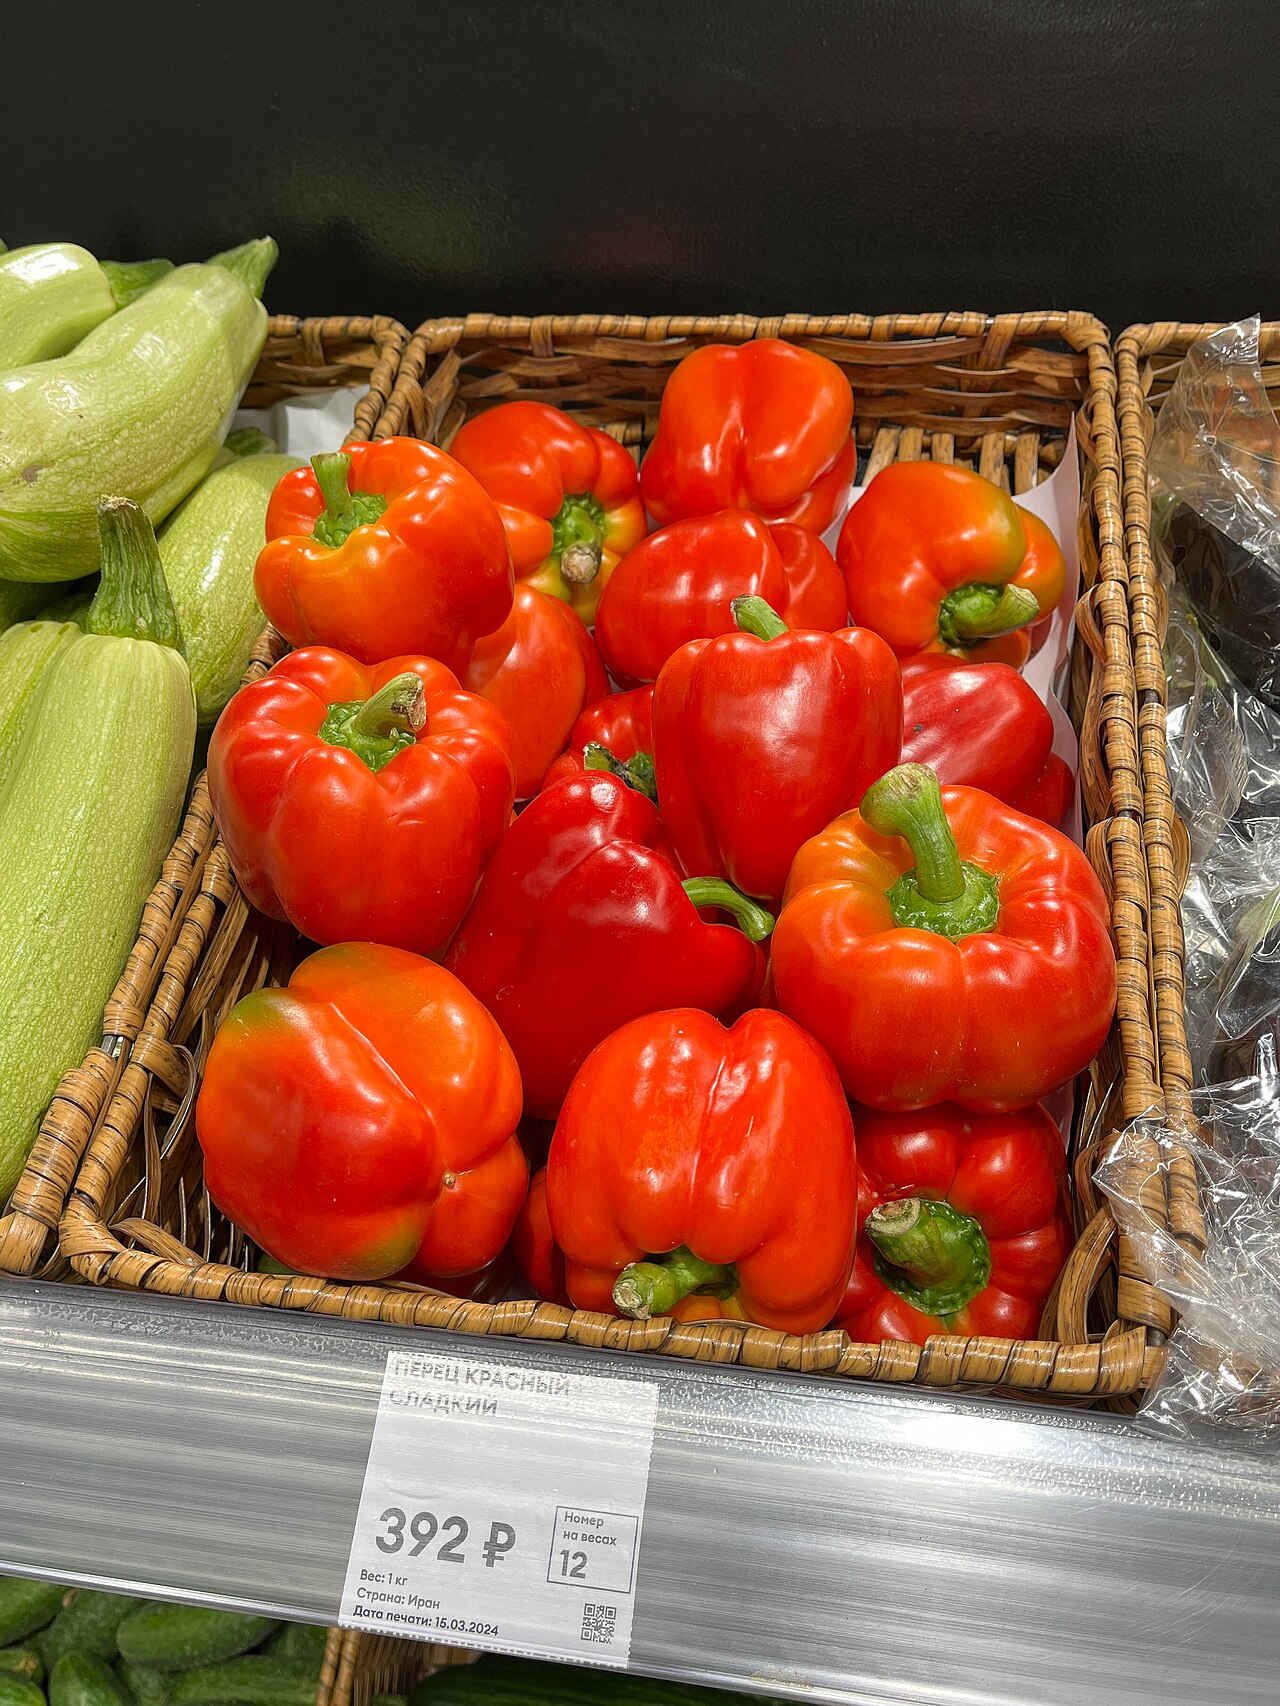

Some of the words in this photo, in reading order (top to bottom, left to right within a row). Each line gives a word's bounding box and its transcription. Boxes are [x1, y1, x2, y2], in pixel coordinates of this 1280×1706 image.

[465, 1366, 572, 1396] КРАСНЫЙ
[564, 1511, 604, 1529] Номер
[375, 1507, 469, 1564] 392
[563, 1530, 579, 1542] на
[580, 1531, 617, 1547] весах
[559, 1549, 588, 1579] 12
[359, 1569, 385, 1584] Вес:
[387, 1572, 393, 1585] 1
[395, 1575, 408, 1587] кг
[356, 1587, 405, 1607] Страна:
[408, 1591, 440, 1610] Иран
[353, 1604, 383, 1621] Дата
[386, 1611, 433, 1628] печати:
[435, 1616, 499, 1636] 15.03.2024
